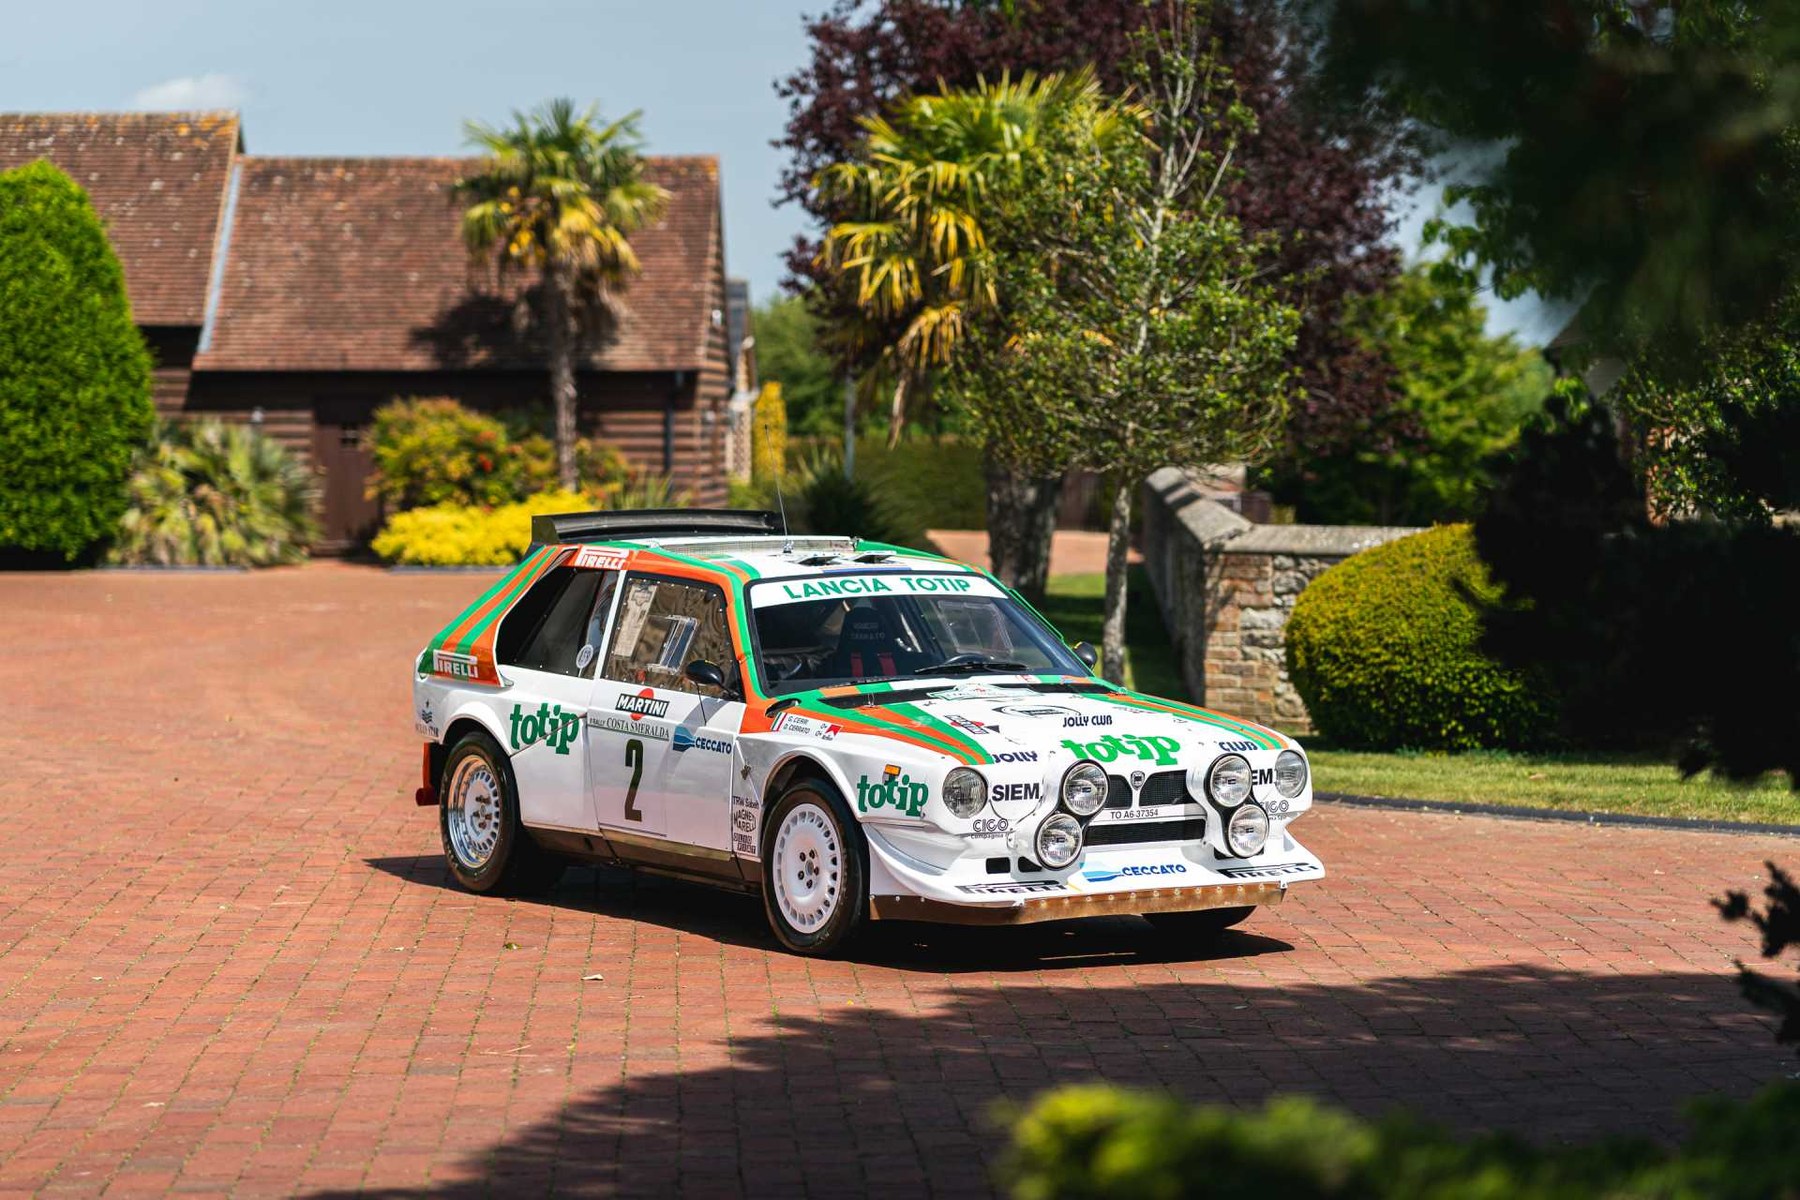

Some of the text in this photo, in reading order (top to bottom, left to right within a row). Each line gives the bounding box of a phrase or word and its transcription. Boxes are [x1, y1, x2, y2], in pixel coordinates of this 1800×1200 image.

[574, 545, 629, 570] PIRELLI
[783, 577, 971, 599] LANCIA TOTIP
[433, 649, 478, 678] PIRELLI
[617, 697, 668, 716] MARTINI
[510, 703, 579, 755] totip
[607, 718, 629, 732] COSTA
[631, 722, 669, 738] SMERALDA
[1063, 715, 1112, 728] JOLLY CLUB
[695, 737, 732, 754] CECCATO
[1060, 734, 1181, 766] totip
[1219, 742, 1258, 751] CLUB
[992, 751, 1038, 763] JOLLY
[625, 739, 643, 822] 2
[1252, 769, 1273, 785] EM
[857, 774, 929, 817] totip
[992, 783, 1040, 801] SIEM
[1111, 809, 1158, 819] TO A6 37354
[1260, 800, 1289, 813] ICO
[973, 819, 1008, 832] CICO
[1122, 864, 1187, 876] CECCATO
[1217, 862, 1319, 879] PIRELLI
[954, 880, 1067, 894] PIRELLI
